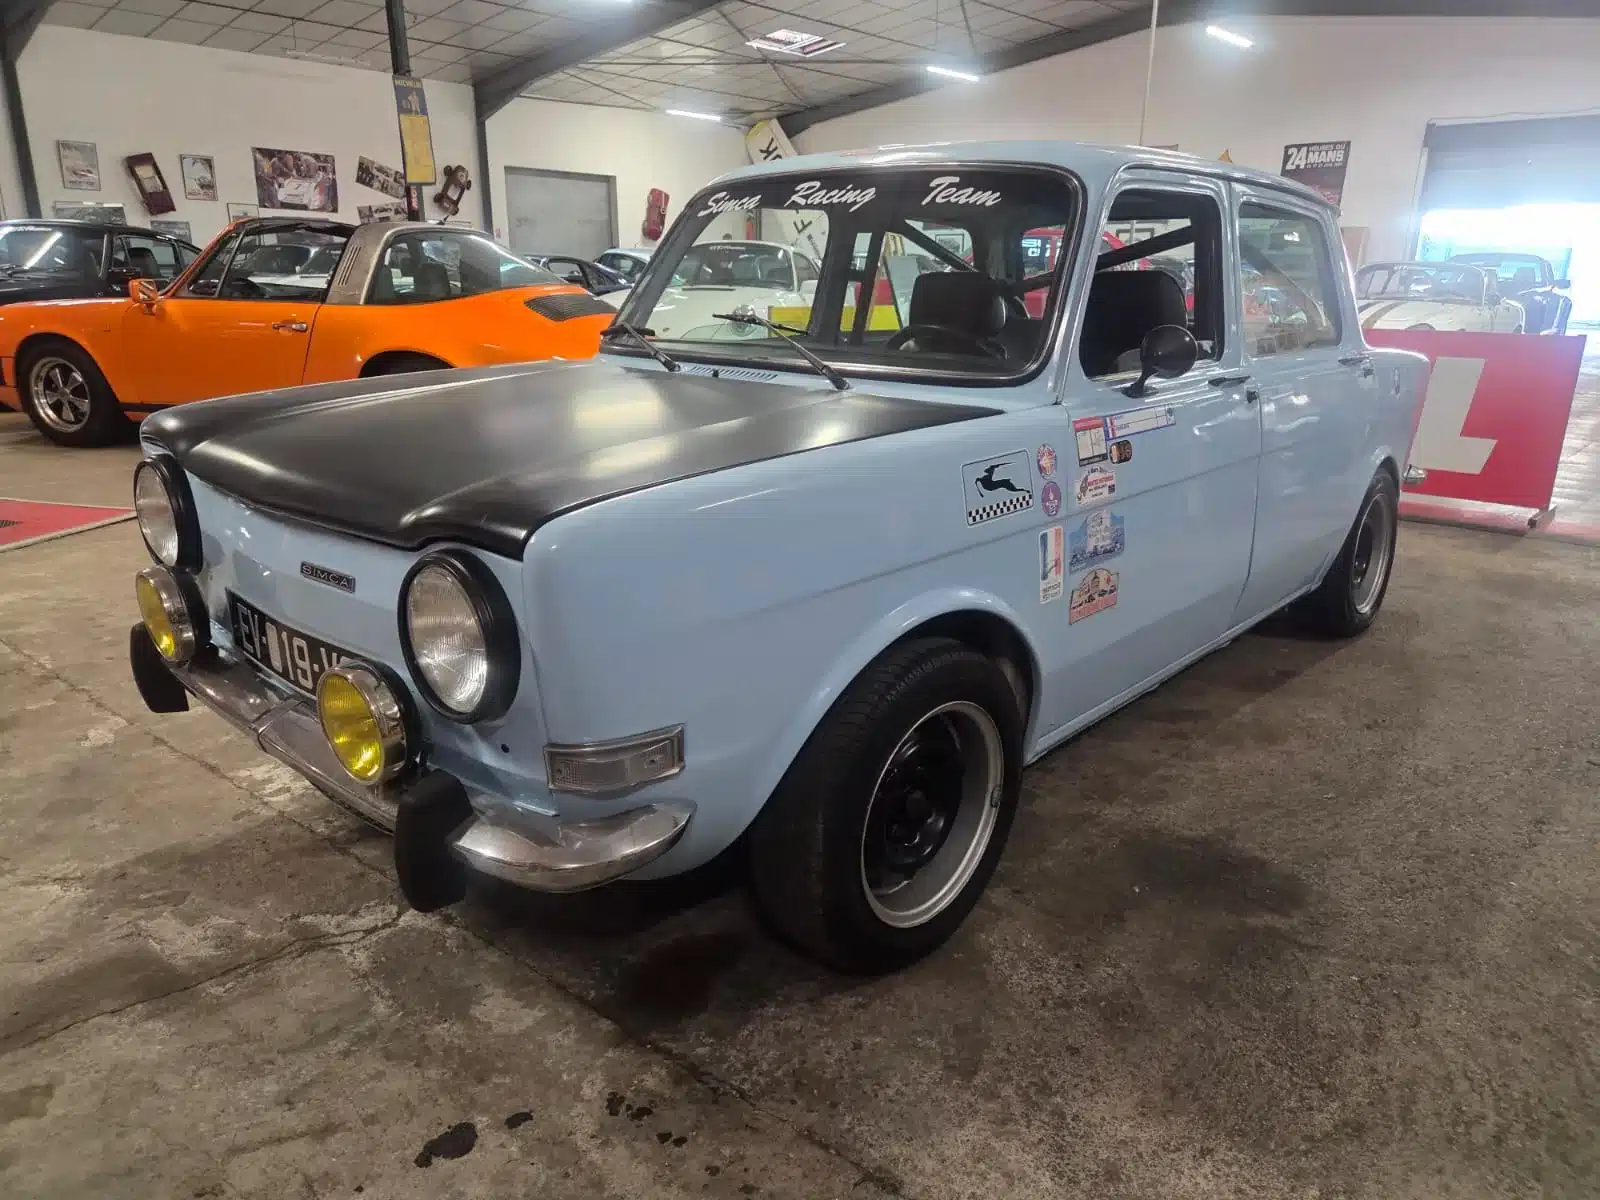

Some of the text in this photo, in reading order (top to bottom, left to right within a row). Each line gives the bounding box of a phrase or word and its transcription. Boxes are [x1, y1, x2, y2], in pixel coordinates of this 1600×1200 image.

[1285, 146, 1308, 169] 24
[1307, 150, 1345, 164] MANS
[697, 176, 1002, 217] Simca Racing Team
[302, 564, 352, 589] SIMCA
